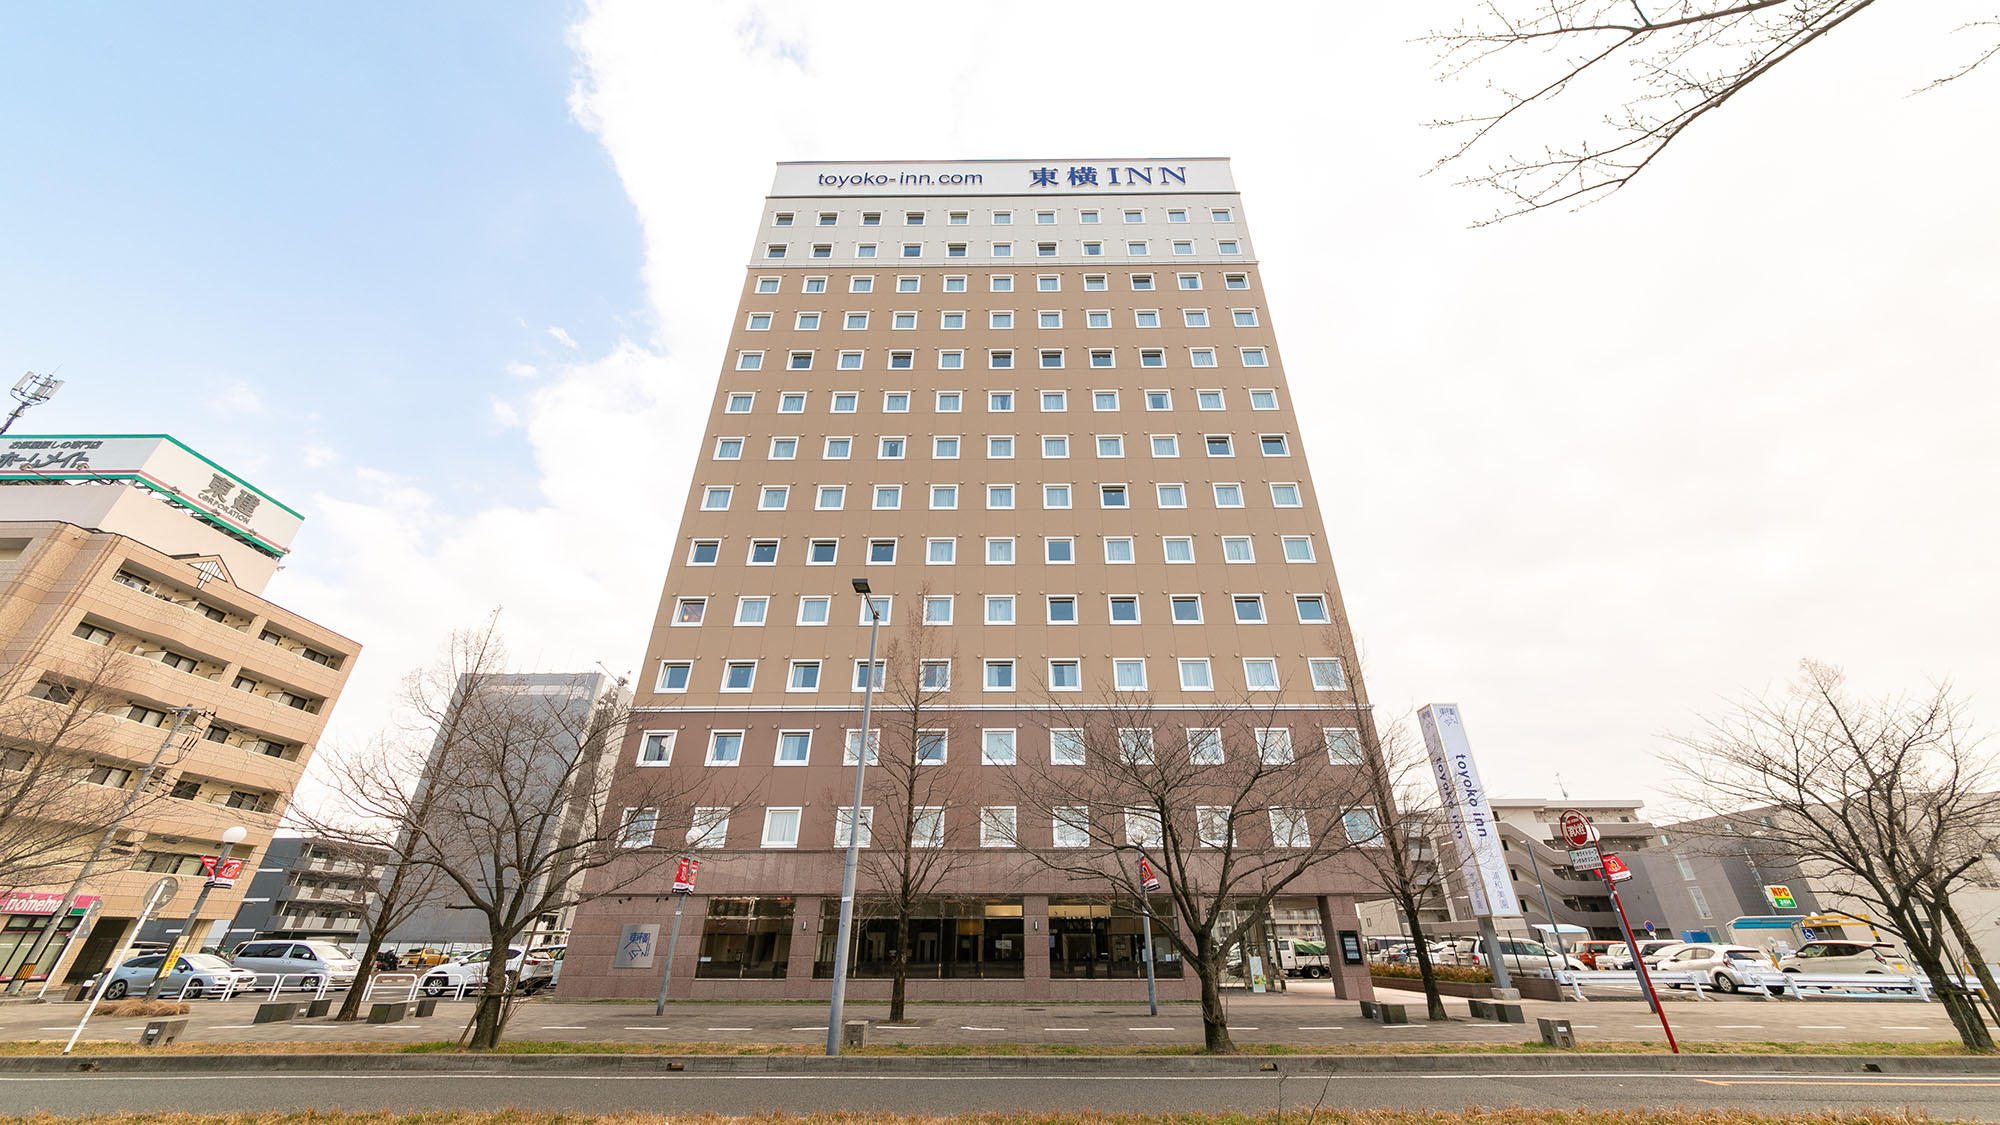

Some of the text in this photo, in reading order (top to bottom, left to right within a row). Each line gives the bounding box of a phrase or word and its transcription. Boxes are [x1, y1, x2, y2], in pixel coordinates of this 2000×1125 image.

[818, 171, 983, 188] toyoko-inn.com
[198, 492, 251, 525] CORPORATION
[201, 473, 260, 518] 東建
[1455, 754, 1487, 837] toyoko inn
[1770, 887, 1790, 897] NPC
